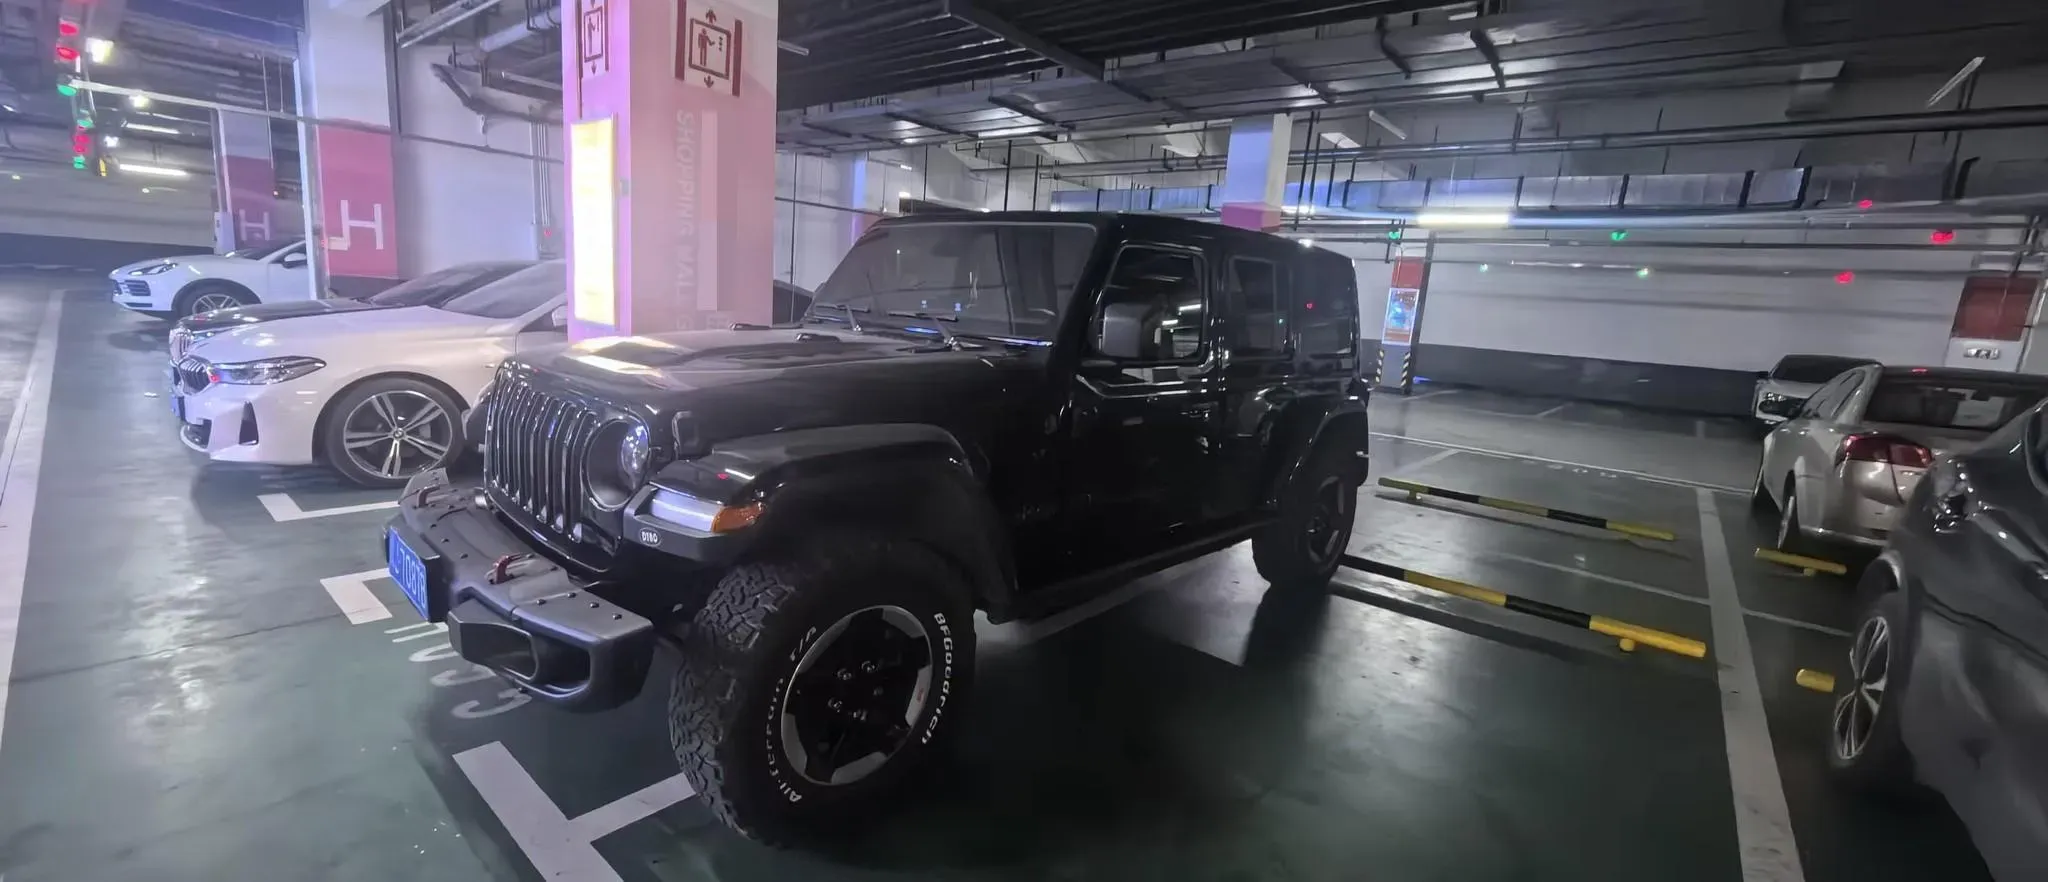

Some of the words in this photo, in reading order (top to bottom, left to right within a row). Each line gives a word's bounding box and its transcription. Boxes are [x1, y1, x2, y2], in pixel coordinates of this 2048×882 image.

[675, 109, 697, 237] SHOPPING
[238, 208, 271, 241] H
[340, 199, 384, 251] H
